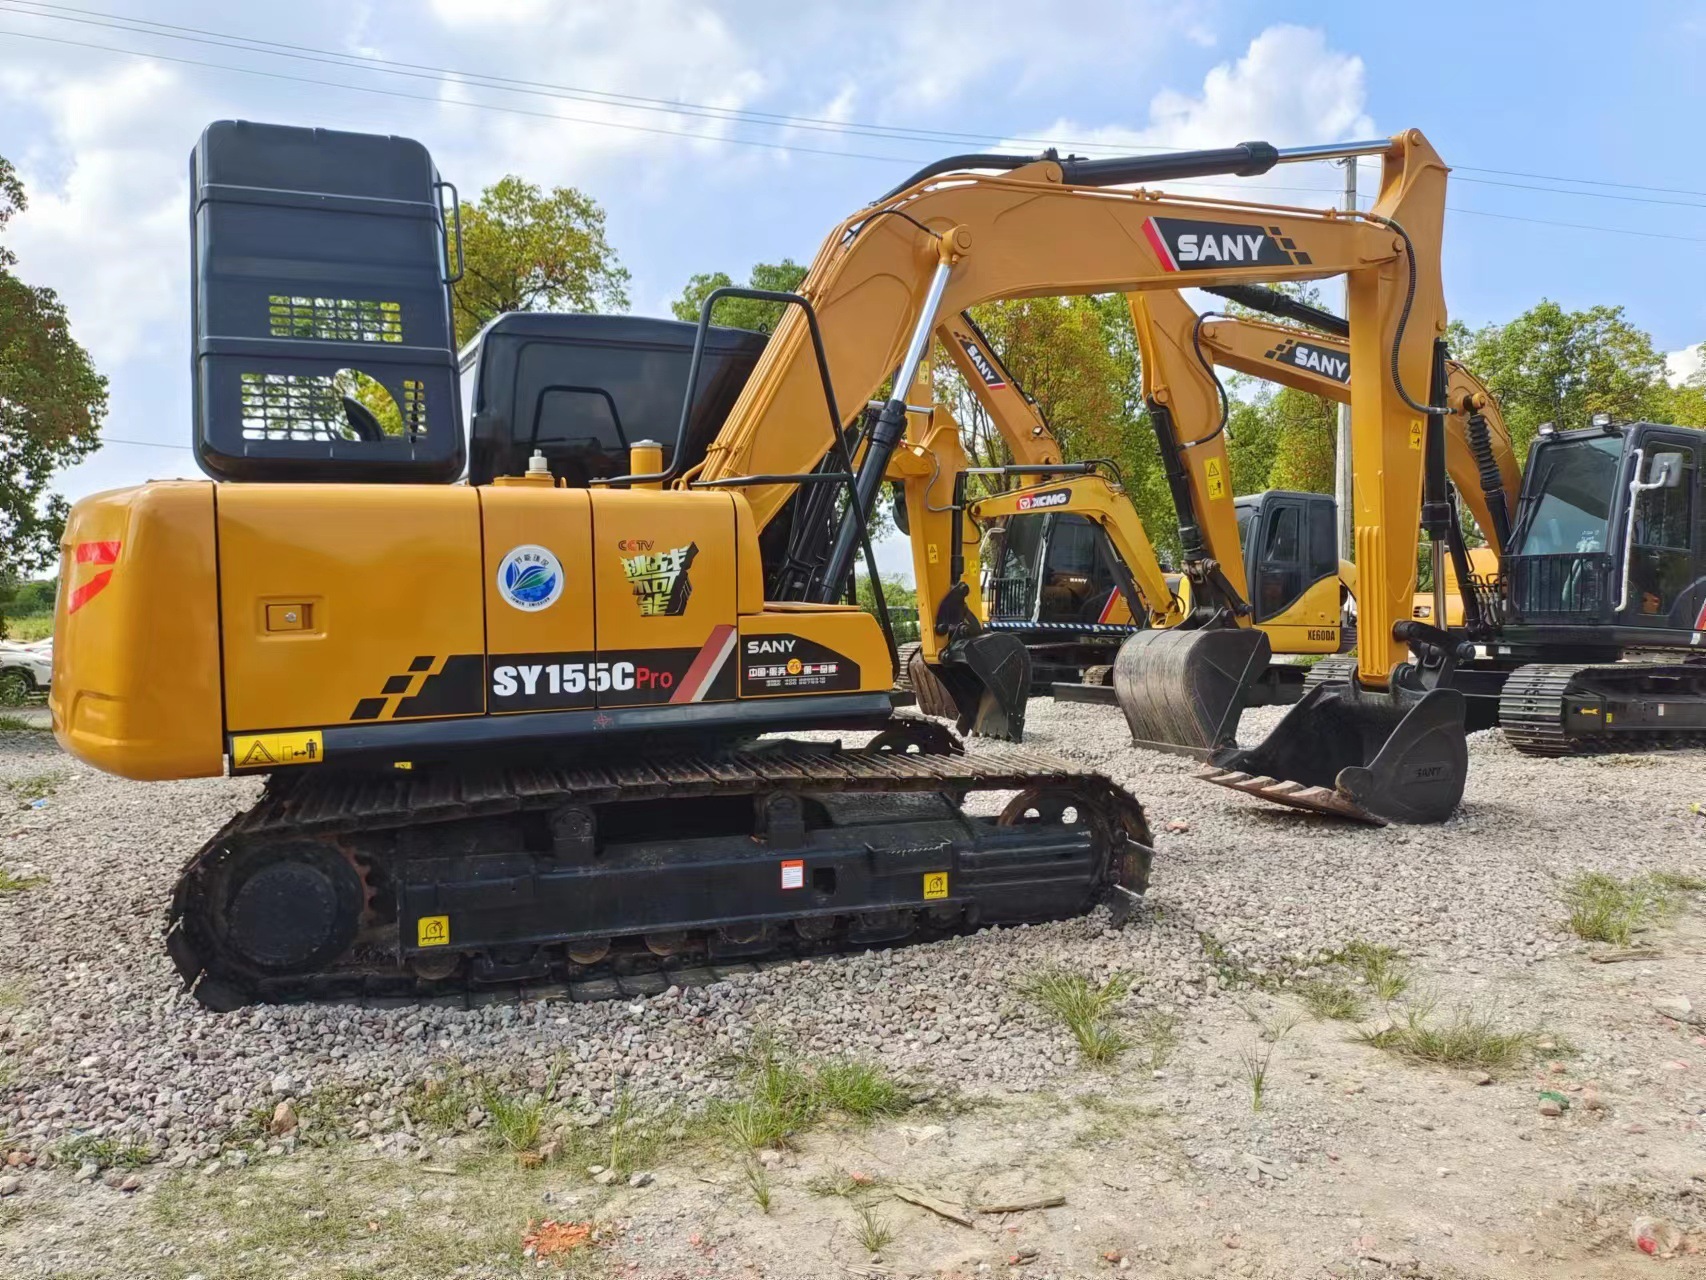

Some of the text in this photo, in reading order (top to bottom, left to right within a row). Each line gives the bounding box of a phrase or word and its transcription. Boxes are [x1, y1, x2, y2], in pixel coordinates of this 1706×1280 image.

[1177, 234, 1264, 262] SANY
[967, 345, 995, 381] SANY
[1294, 346, 1348, 378] SANY
[1031, 493, 1067, 508] XCMG
[618, 540, 654, 551] CCTV
[620, 546, 689, 578] 挑战
[626, 570, 681, 595] 不可
[637, 593, 672, 617] 能
[747, 640, 796, 654] SANY
[1307, 630, 1336, 641] XE60DA
[493, 662, 673, 697] SY155C Pro
